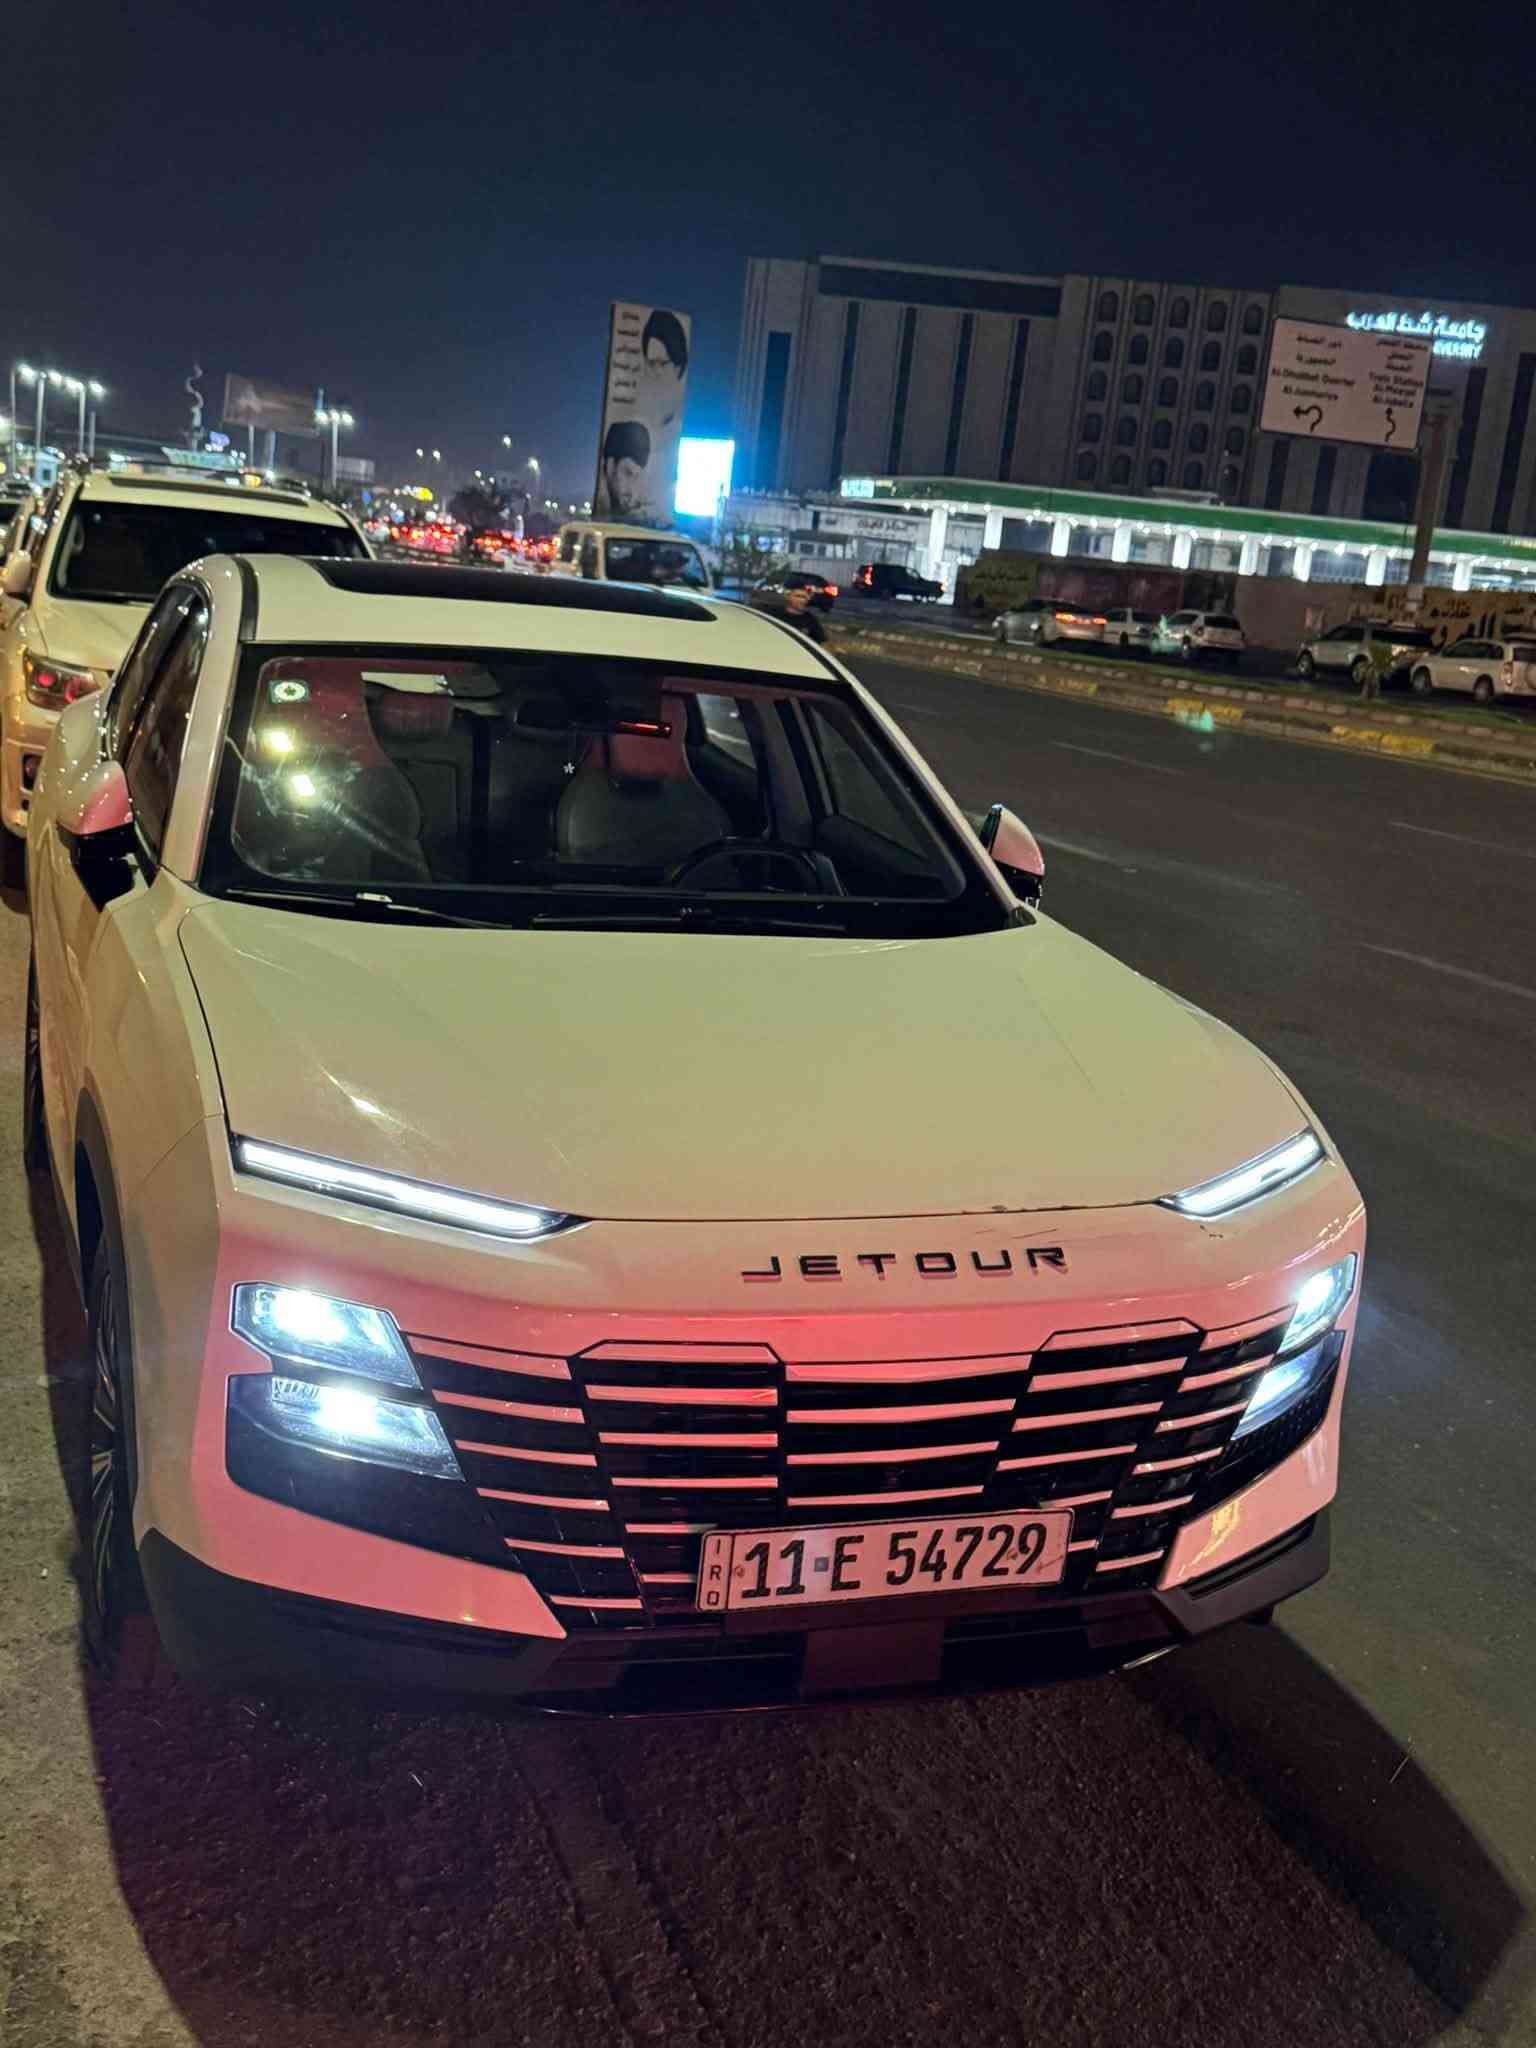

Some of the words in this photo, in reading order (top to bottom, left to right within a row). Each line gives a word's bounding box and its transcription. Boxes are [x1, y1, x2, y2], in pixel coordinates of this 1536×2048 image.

[1346, 311, 1395, 331] العرب
[1396, 311, 1432, 336] شط
[1433, 314, 1486, 340] جامعة
[741, 1246, 1066, 1277] JETOUR
[741, 1539, 806, 1598] 11
[830, 1534, 864, 1592] E
[886, 1522, 1047, 1586] 54729
